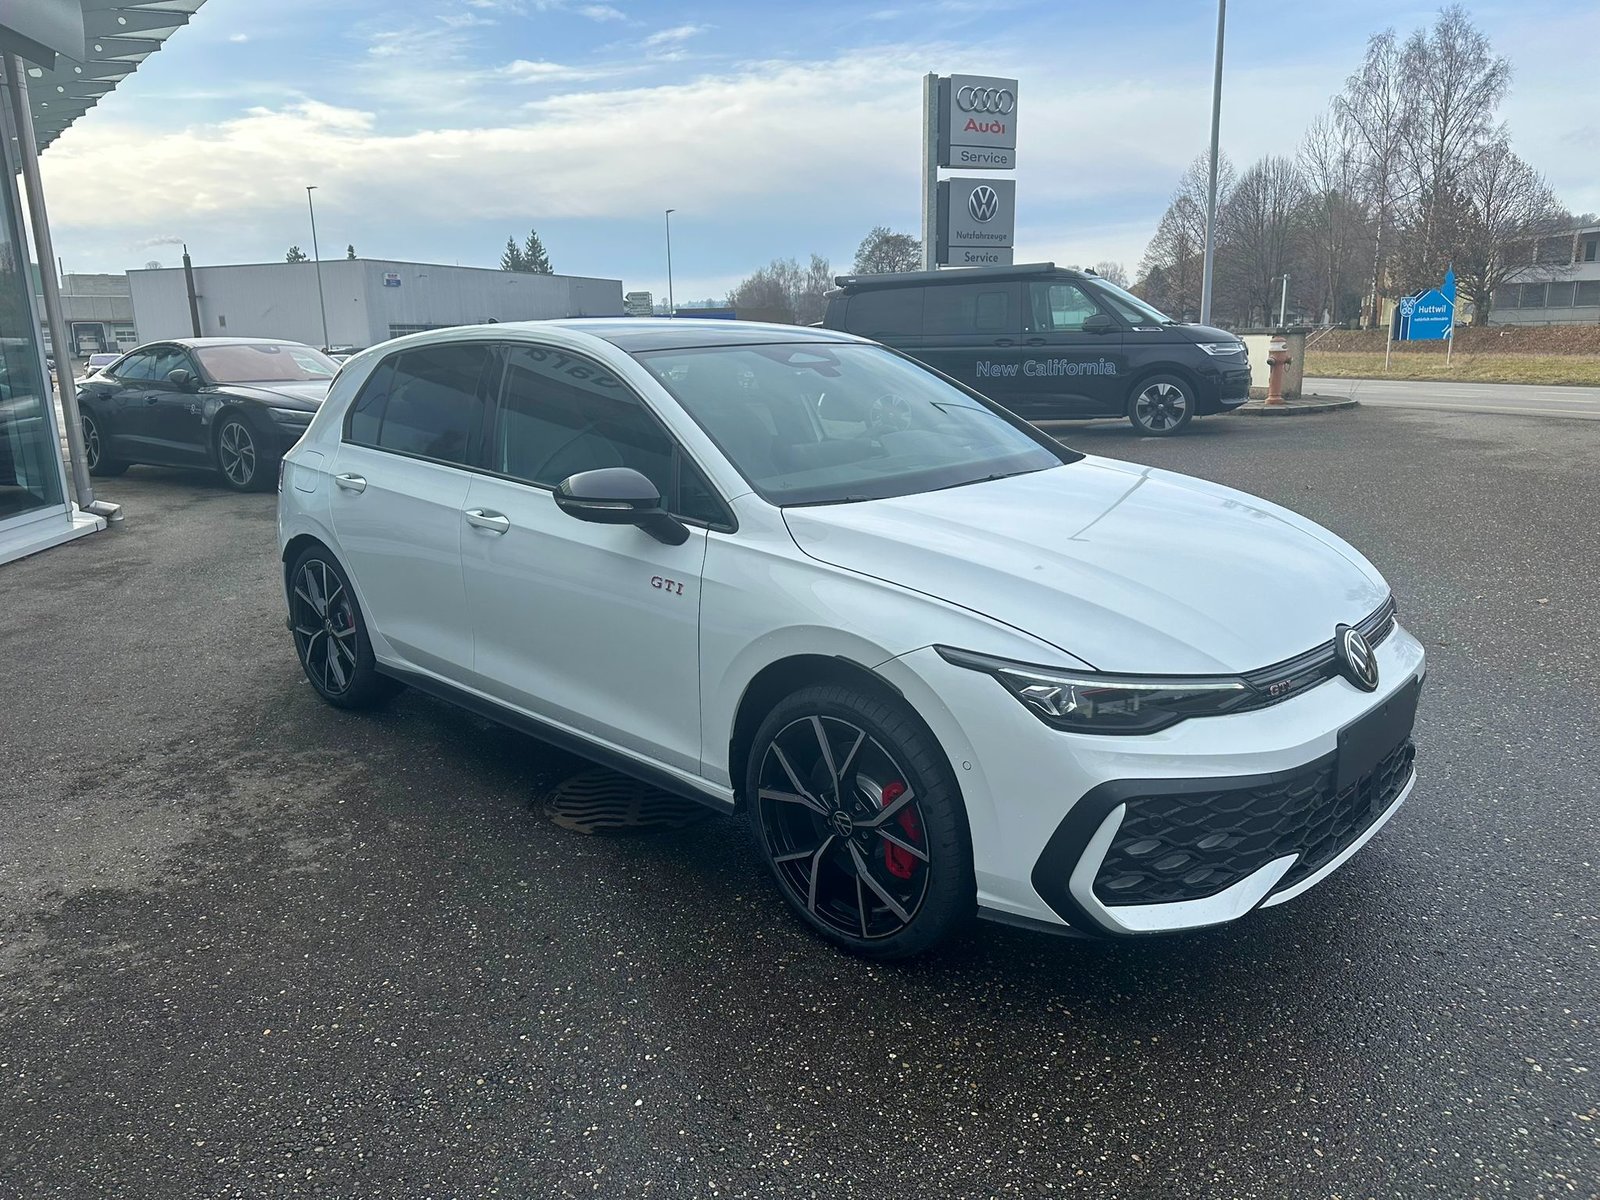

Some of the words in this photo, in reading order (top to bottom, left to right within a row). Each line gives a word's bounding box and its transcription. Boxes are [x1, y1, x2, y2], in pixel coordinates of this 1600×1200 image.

[963, 118, 1006, 134] Audi
[961, 150, 1008, 164] Service
[956, 231, 1008, 242] Nutzfahrzeuge
[964, 251, 999, 263] Service
[1418, 304, 1447, 314] Huttwil
[976, 360, 1019, 377] New
[1023, 357, 1117, 377] California
[650, 575, 684, 596] GTI
[1269, 679, 1291, 696] GTI
